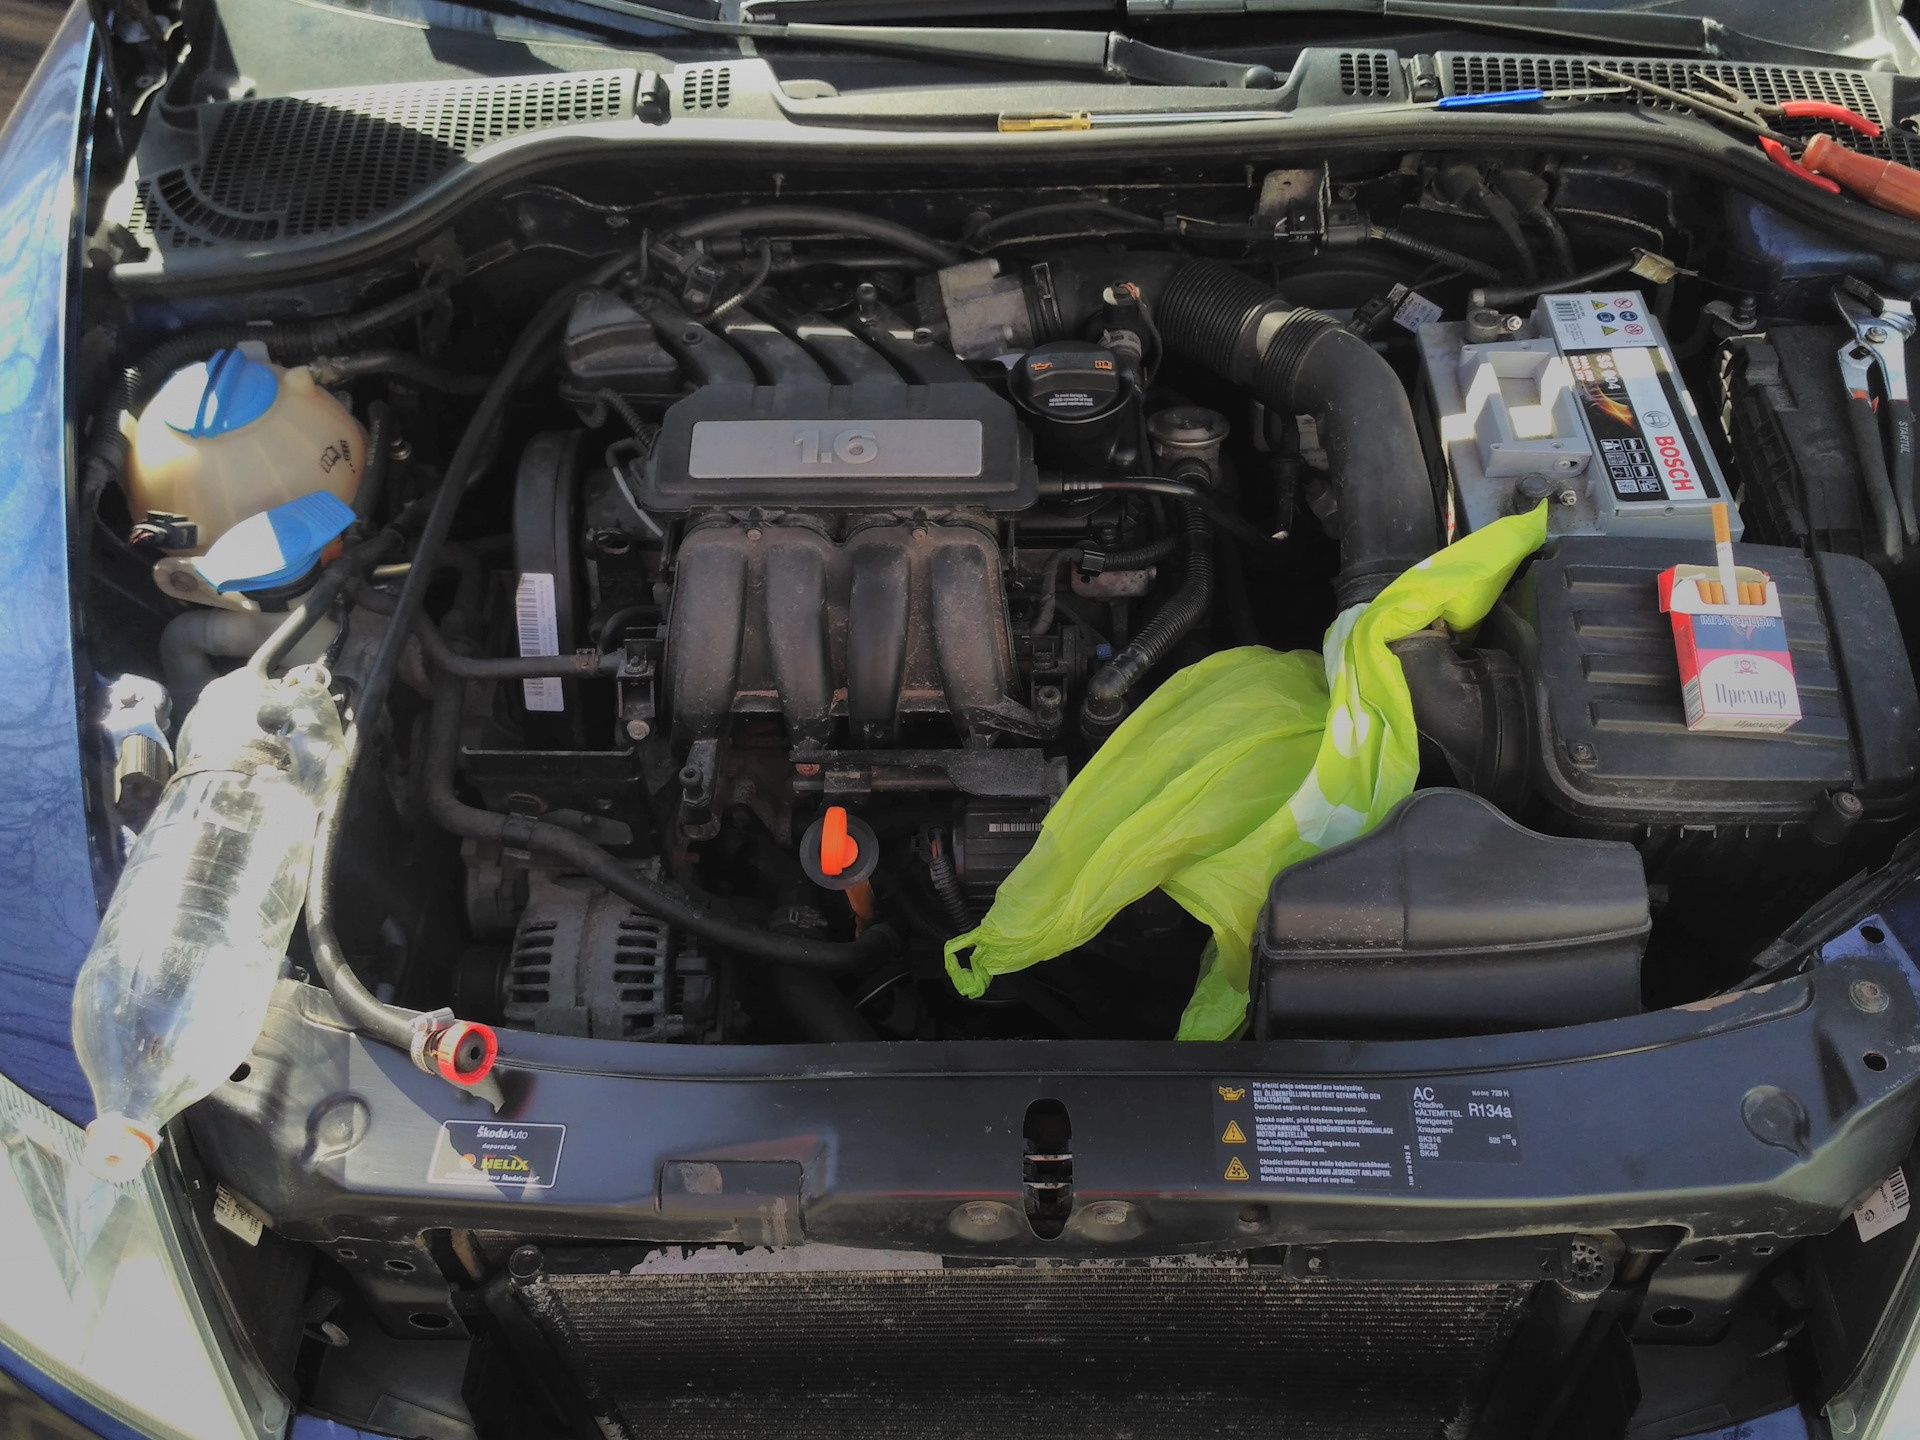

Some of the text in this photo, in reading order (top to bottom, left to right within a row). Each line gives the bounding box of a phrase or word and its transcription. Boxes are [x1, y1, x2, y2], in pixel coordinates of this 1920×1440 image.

[1899, 420, 1911, 454] STARTUL
[794, 429, 878, 464] 1.6
[1654, 436, 1695, 491] BOSCH
[1715, 683, 1787, 709] Премьер
[1336, 1091, 1357, 1099] GEFAHR
[1358, 1091, 1369, 1099] FÜR
[1413, 1087, 1434, 1101] AC
[1321, 1105, 1343, 1113] damage
[1413, 1101, 1444, 1109] Chladivo
[1415, 1109, 1463, 1117] KÄLTEMITTEL
[1468, 1103, 1512, 1118] R134a
[1310, 1117, 1333, 1125] dotykem
[1416, 1117, 1454, 1126] Refrigerant
[476, 1125, 528, 1140] ŠkodaAuto
[1316, 1124, 1345, 1133] BERÜHREN
[1358, 1126, 1394, 1134] ZÜNDANLAGE
[1417, 1126, 1454, 1134] Хладагент
[1256, 1138, 1270, 1146] High
[1418, 1135, 1441, 1143] SK316
[1511, 1138, 1517, 1146] g
[1257, 1145, 1281, 1153] touching
[481, 1157, 530, 1171] HELIX
[1260, 1166, 1315, 1174] KÜHLERVENTILATOR
[1332, 1168, 1360, 1176] JEDERZEIT
